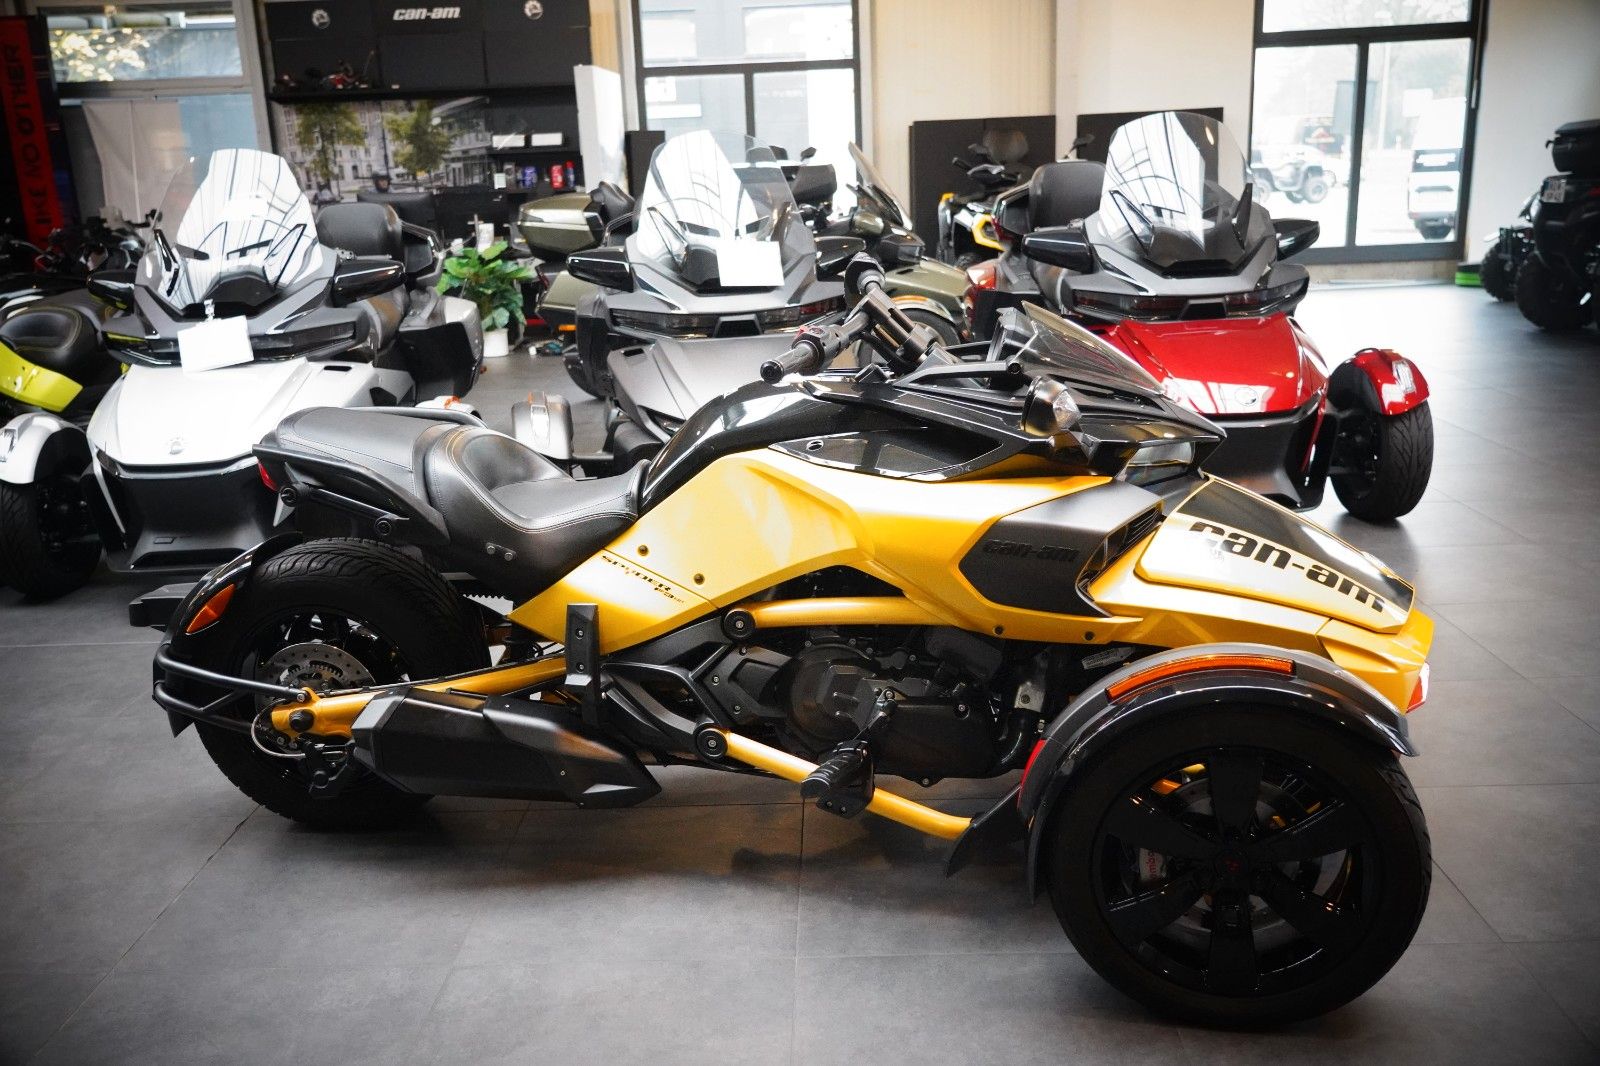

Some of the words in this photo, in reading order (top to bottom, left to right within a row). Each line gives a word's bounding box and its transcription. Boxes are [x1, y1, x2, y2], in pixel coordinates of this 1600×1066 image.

[393, 7, 461, 20] can-am
[5, 43, 35, 135] OTHER
[22, 143, 41, 178] NO
